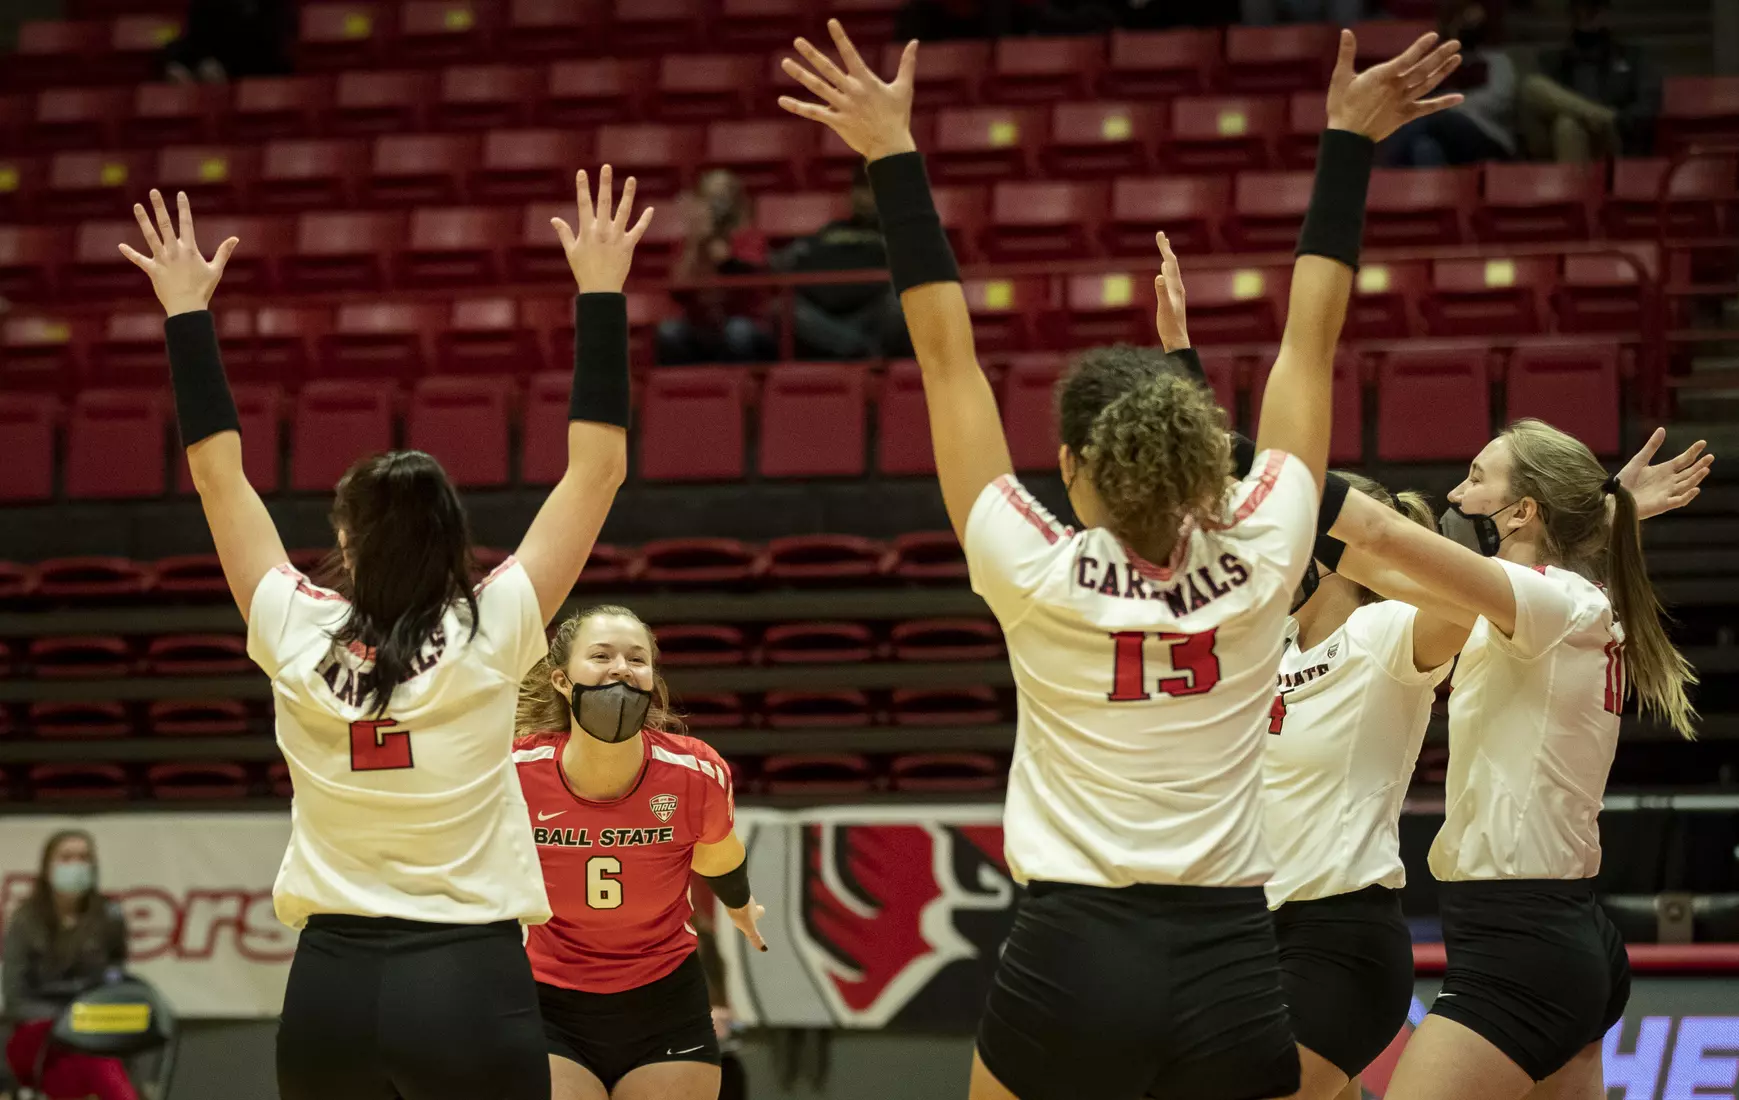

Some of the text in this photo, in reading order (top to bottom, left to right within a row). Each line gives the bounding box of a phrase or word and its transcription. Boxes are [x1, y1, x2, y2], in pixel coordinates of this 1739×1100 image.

[1108, 627, 1221, 701] 13
[652, 802, 676, 812] MAC
[533, 826, 674, 848] BALL STATE
[585, 855, 623, 909] 6
